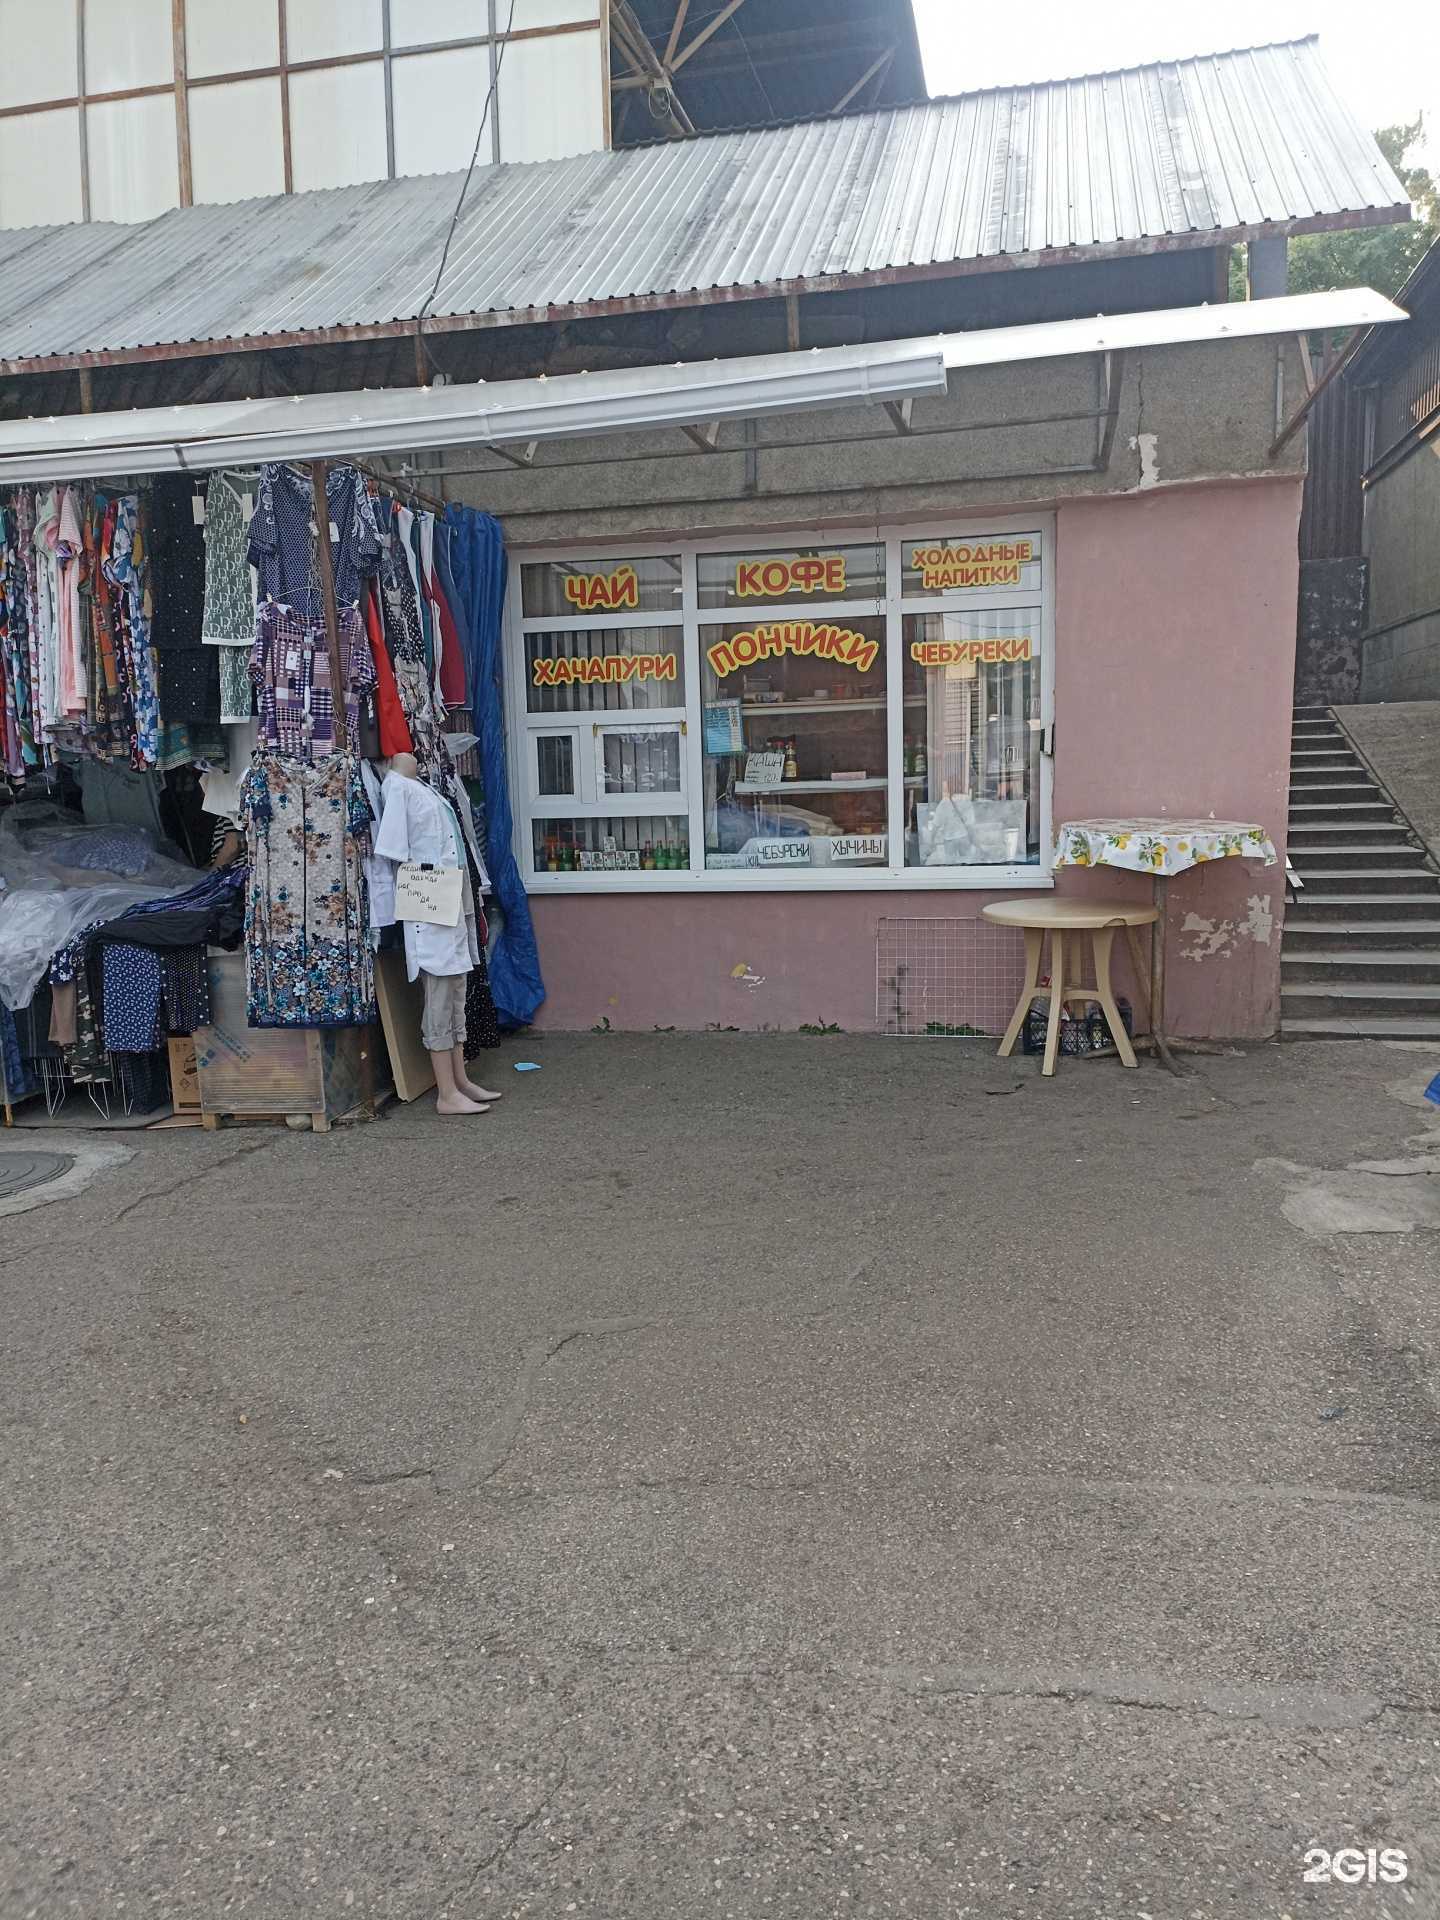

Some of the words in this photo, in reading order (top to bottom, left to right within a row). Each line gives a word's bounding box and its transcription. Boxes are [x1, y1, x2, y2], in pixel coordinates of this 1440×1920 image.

[912, 541, 1032, 568] ХОЛОДНЫЕ
[565, 564, 639, 609] ЧАЙ
[736, 556, 846, 597] КОФЕ
[923, 564, 1020, 588] НАПИТКИ
[707, 622, 878, 677] ПОНЧИКИ
[911, 637, 1032, 666] ЧЕБУРЕКИ
[533, 653, 677, 686] ХАЧАПУРИ
